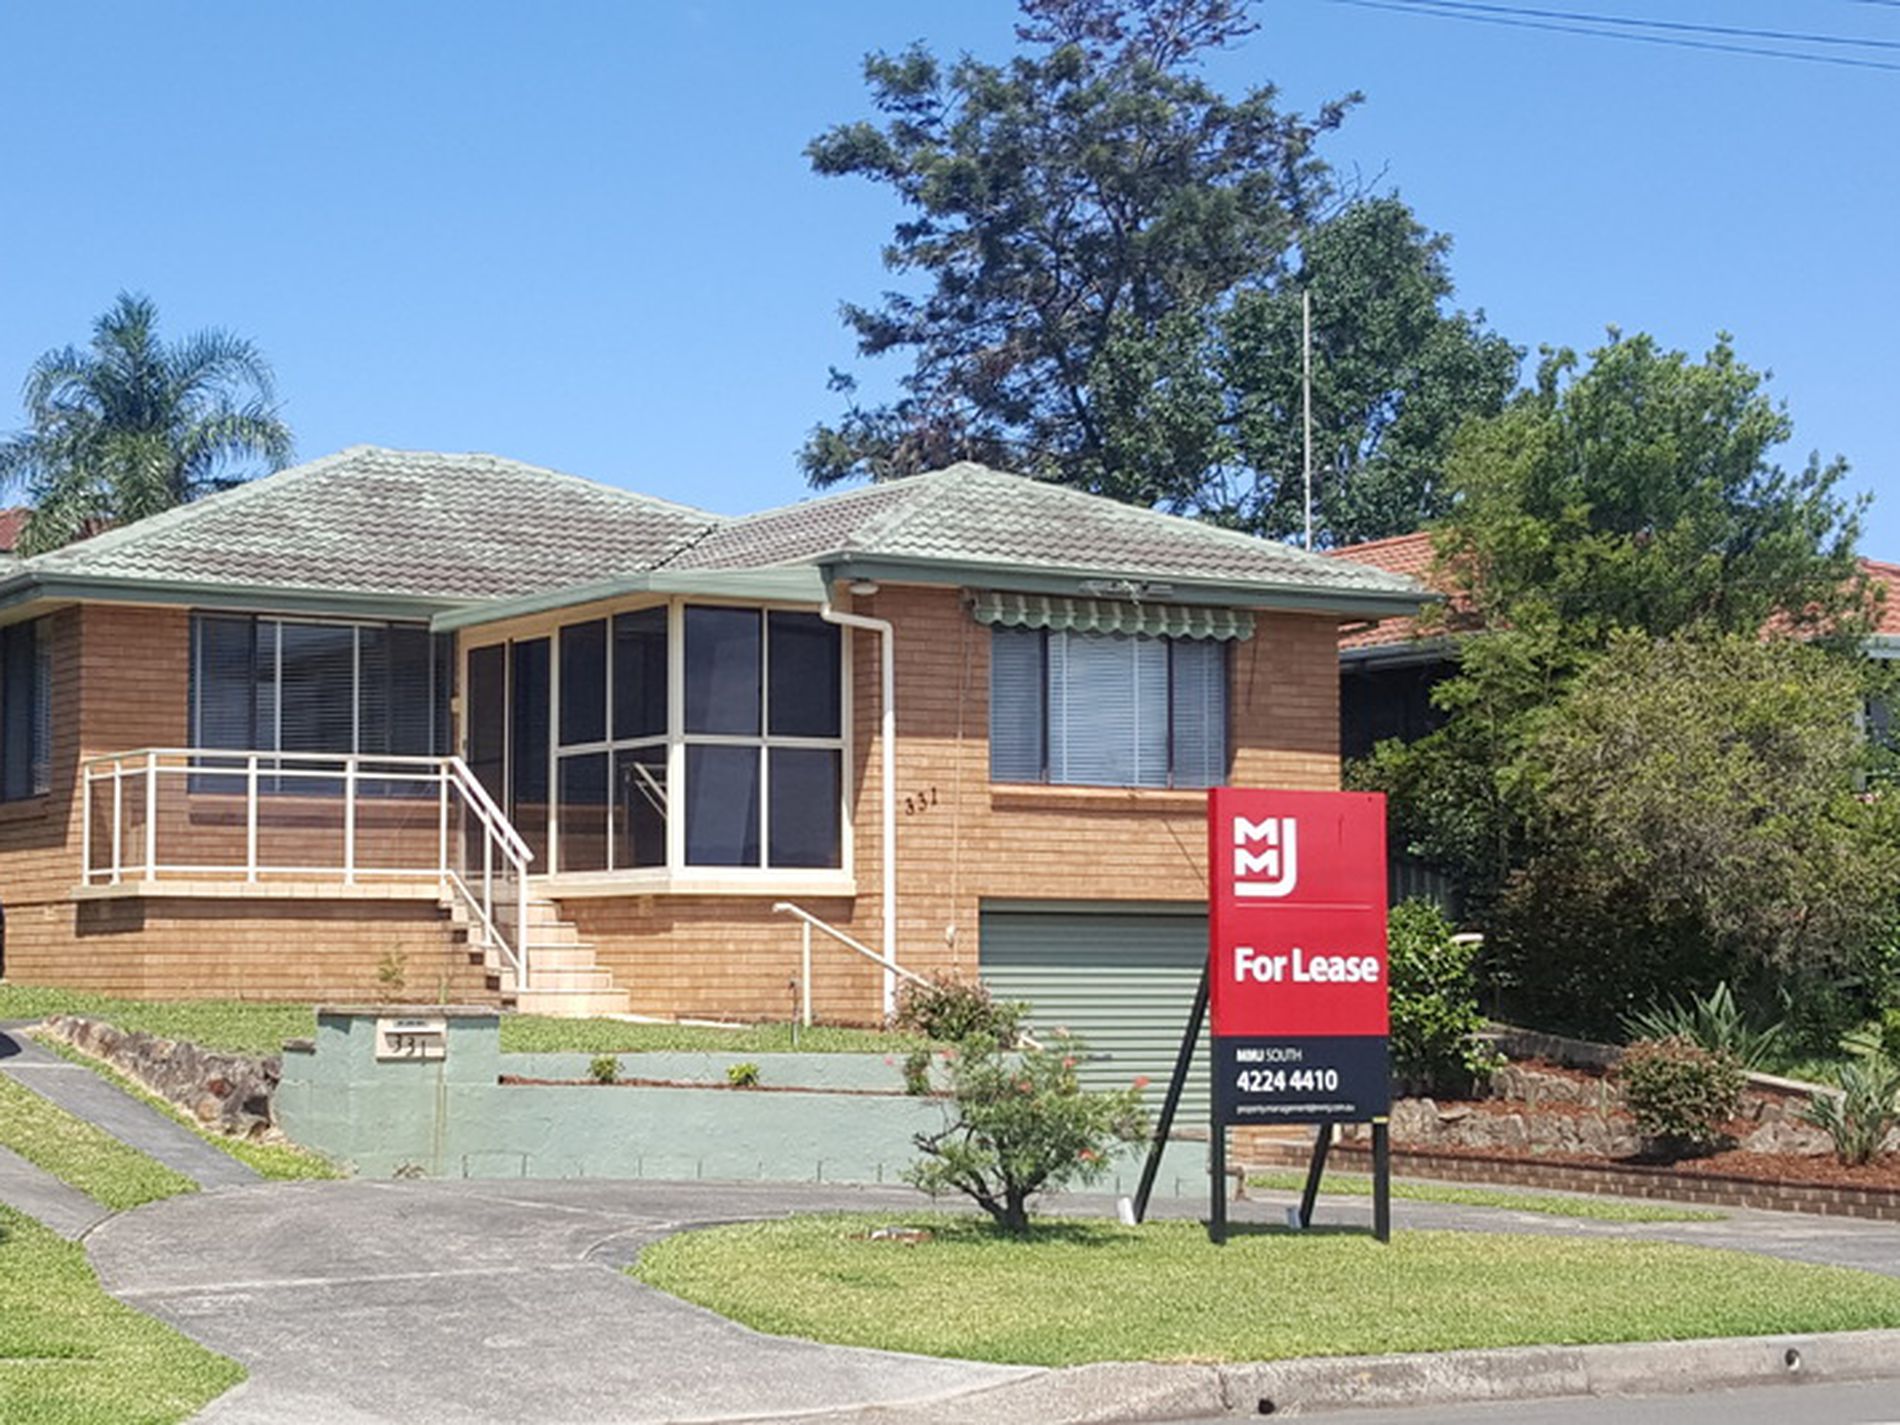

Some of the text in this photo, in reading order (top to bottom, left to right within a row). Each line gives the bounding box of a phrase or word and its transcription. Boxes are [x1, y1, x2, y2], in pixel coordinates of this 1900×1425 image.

[905, 786, 938, 816] 331
[1234, 947, 1379, 982] For Lease
[1266, 1048, 1302, 1062] SOUTH
[1236, 1069, 1338, 1092] 4224 4410
